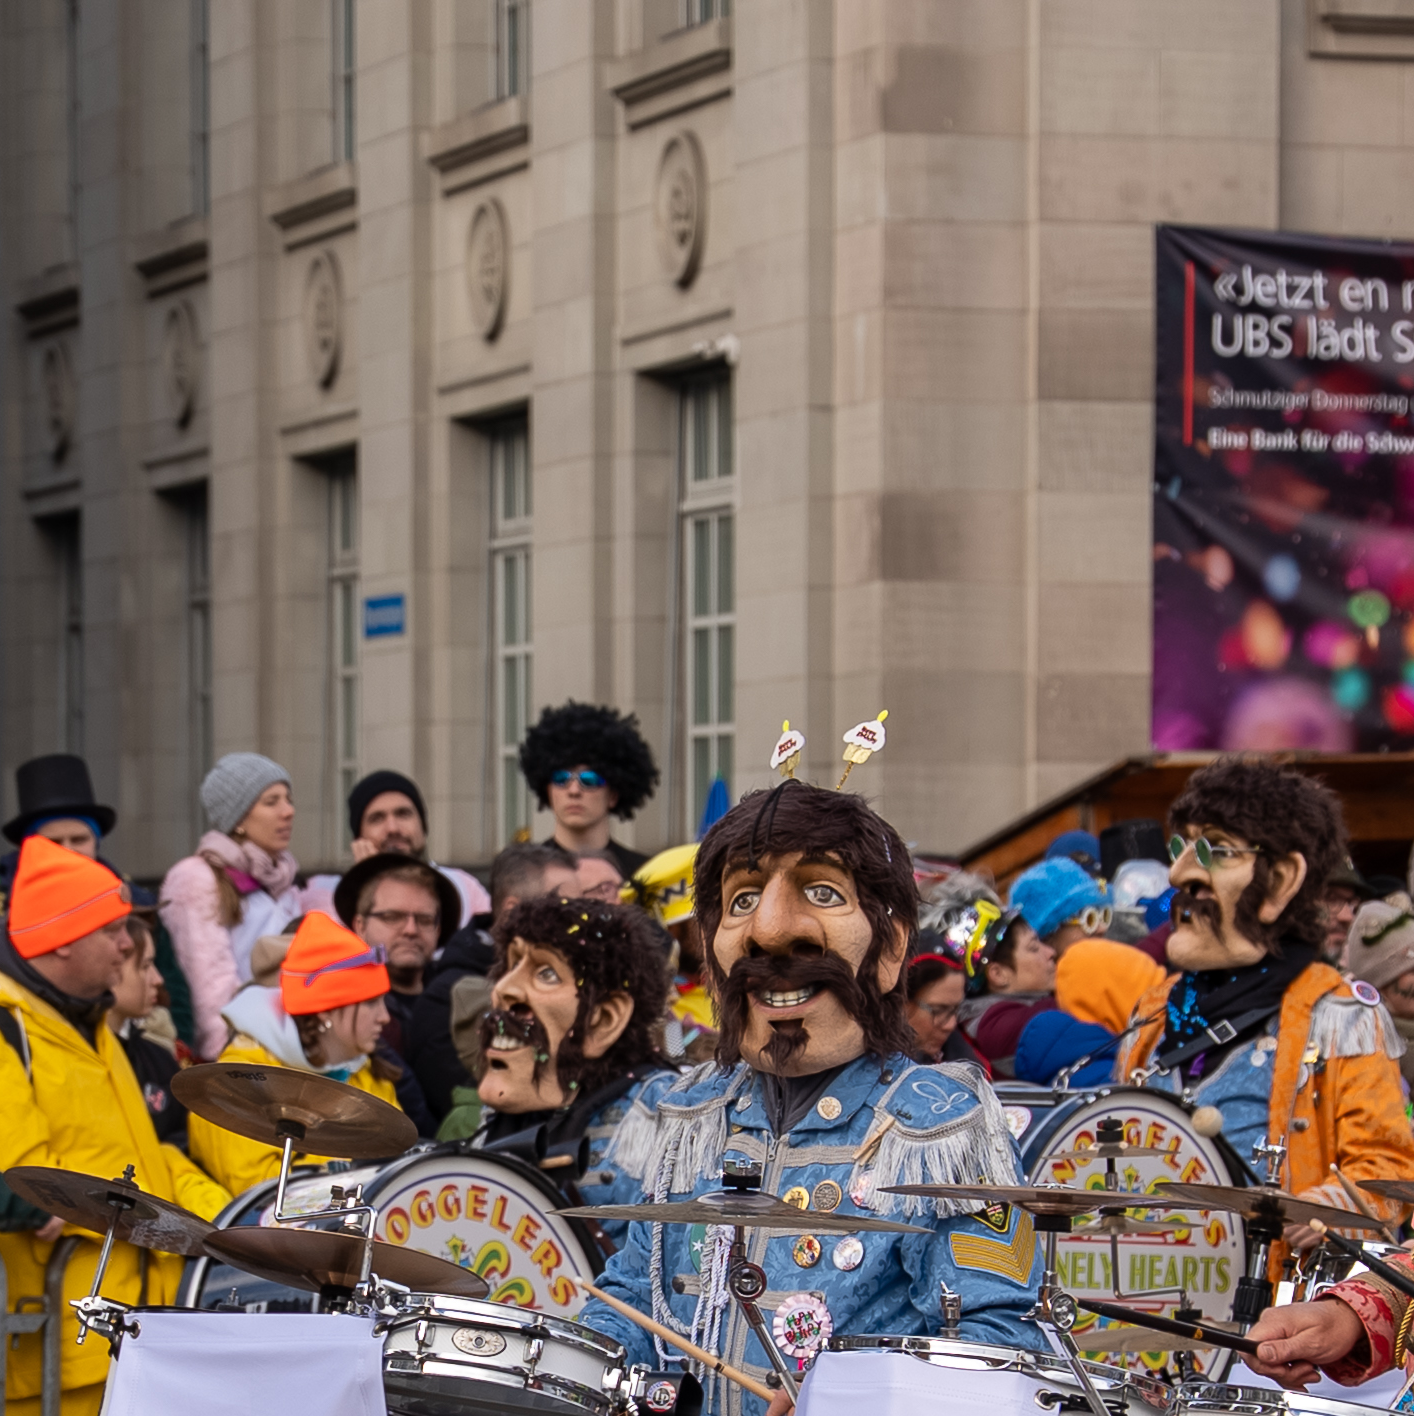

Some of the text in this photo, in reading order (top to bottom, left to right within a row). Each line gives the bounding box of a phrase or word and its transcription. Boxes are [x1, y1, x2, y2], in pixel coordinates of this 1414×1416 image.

[1213, 264, 1327, 310] «Jetzt
[1339, 277, 1388, 313] en
[1211, 312, 1293, 359] UBS
[1306, 315, 1382, 362] lädt
[1130, 1256, 1231, 1294] HEARTS
